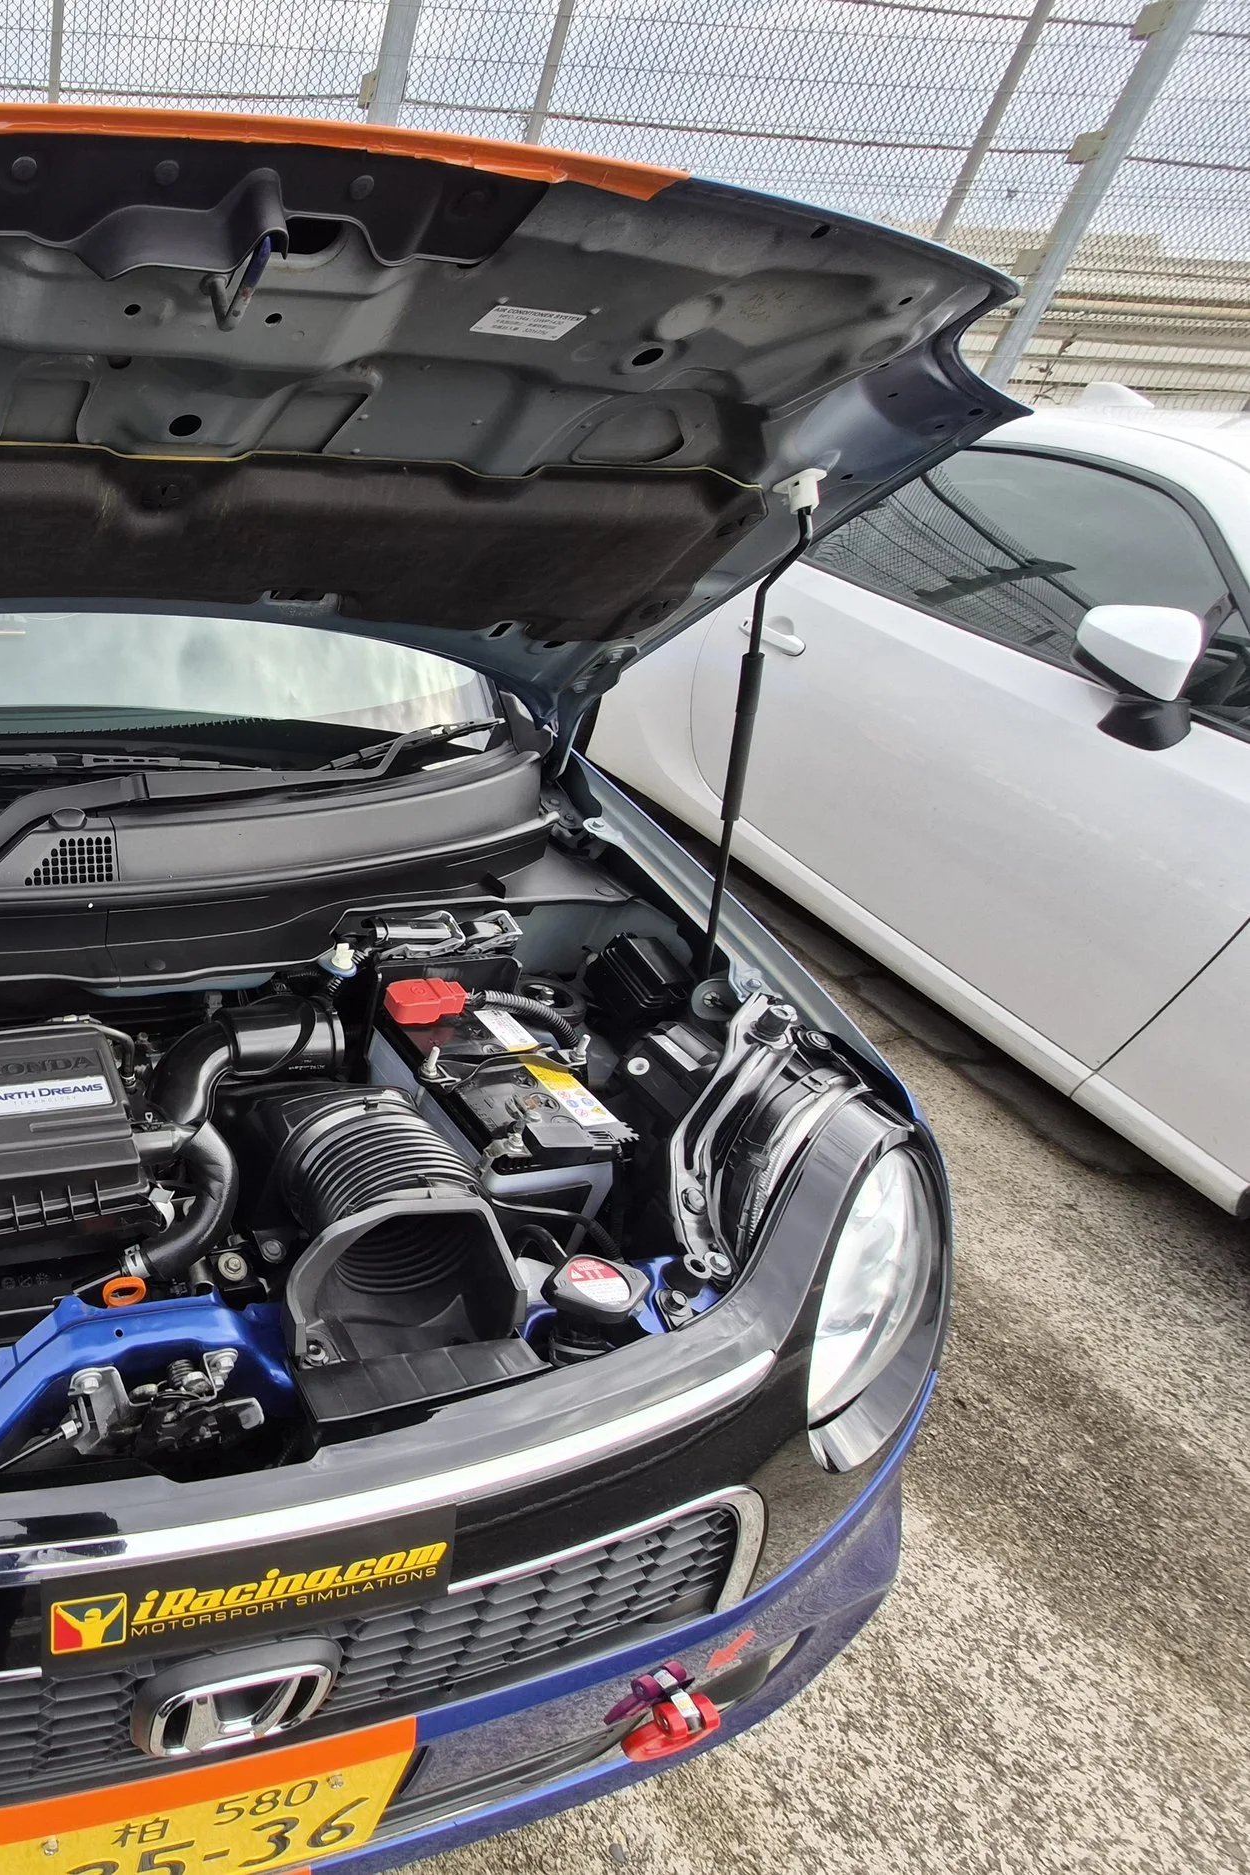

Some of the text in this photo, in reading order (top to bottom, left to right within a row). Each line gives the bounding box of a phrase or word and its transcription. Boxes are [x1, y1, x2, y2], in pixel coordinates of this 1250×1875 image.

[38, 1083, 104, 1097] DREAMS
[130, 1566, 438, 1638] MOTORSPORT SIMULATIONS
[133, 1542, 447, 1621] iRacing.com
[111, 1779, 319, 1848] 柏 580
